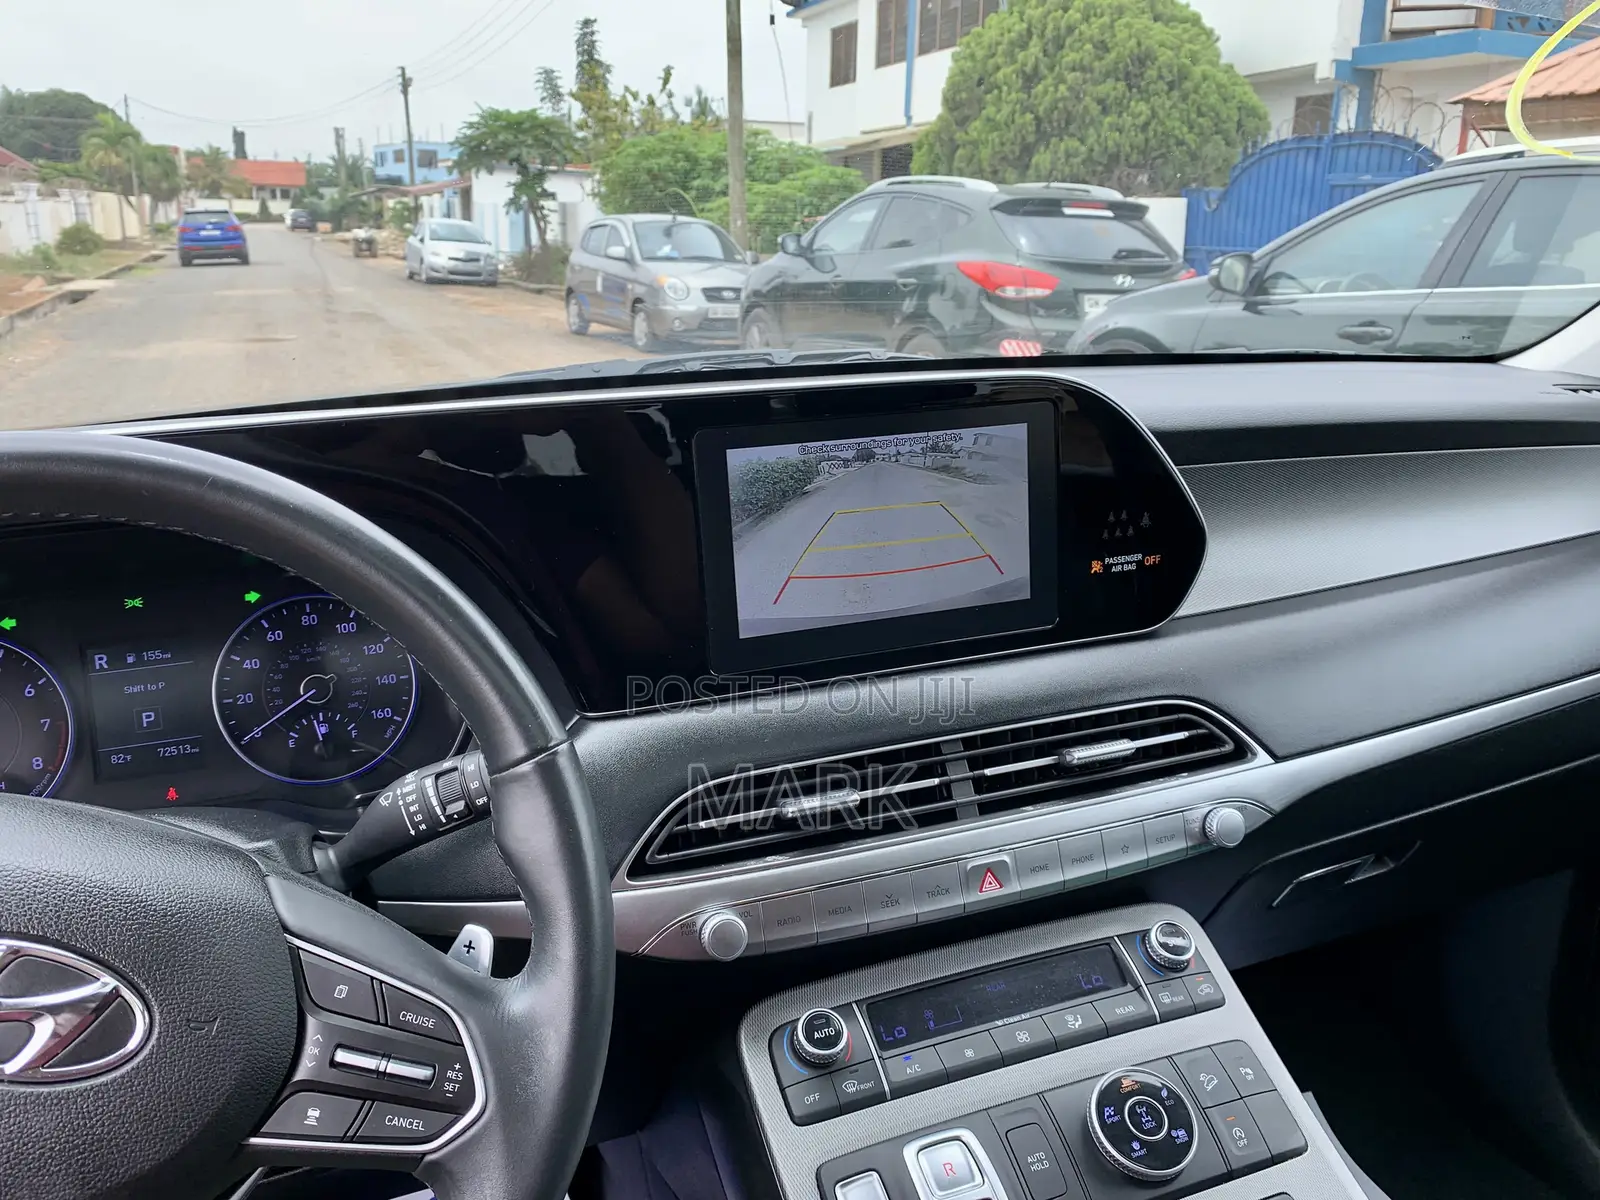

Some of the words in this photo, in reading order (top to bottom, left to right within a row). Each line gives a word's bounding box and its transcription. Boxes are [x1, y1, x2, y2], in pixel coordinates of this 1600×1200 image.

[798, 445, 828, 455] Check
[829, 440, 892, 452] surroundings
[894, 437, 908, 446] for
[909, 436, 931, 447] your
[932, 433, 963, 443] safety.
[1104, 554, 1142, 564] PASSENGER
[1144, 554, 1161, 565] OFF
[1123, 563, 1136, 571] BAG
[301, 614, 318, 626] 80
[336, 622, 356, 633] 100
[266, 630, 283, 642] 60
[362, 643, 384, 655] 120
[94, 654, 108, 669] R
[243, 658, 260, 669] 40
[376, 674, 397, 685] 140
[24, 684, 35, 697] 6
[124, 684, 144, 694] Shift
[147, 683, 156, 691] to
[236, 693, 254, 704] 20
[371, 708, 392, 719] 160
[40, 719, 50, 731] 7
[142, 712, 155, 727] P
[352, 730, 358, 738] F
[384, 724, 396, 739] MPH
[288, 739, 296, 748] E
[32, 757, 43, 770] 8
[402, 783, 416, 793] MIST
[470, 780, 479, 789] LO
[406, 794, 417, 803] OFF
[475, 796, 488, 806] OFF
[409, 804, 419, 812] INT
[1155, 834, 1176, 844] SETUP
[1071, 854, 1094, 864] PHONE
[1029, 863, 1050, 874] HOME
[926, 888, 950, 899] TRACK
[880, 898, 900, 909] SEEK
[828, 905, 852, 916] MEDIA
[680, 921, 696, 930] PWR
[777, 916, 801, 927] RADIO
[1114, 1005, 1135, 1015] REAR
[399, 1010, 435, 1028] CRUISE
[814, 1027, 835, 1040] AUTO
[308, 1046, 319, 1056] OK
[906, 1064, 922, 1075] A/C
[446, 1070, 463, 1081] RES
[444, 1082, 460, 1092] SET
[856, 1081, 875, 1092] FRONT
[1120, 1084, 1141, 1094] COMFORT
[804, 1093, 820, 1105] OFF
[385, 1115, 425, 1131] CANCEL
[1106, 1115, 1121, 1124] SPORT
[1142, 1121, 1157, 1130] LOCK
[1237, 1138, 1248, 1147] OFF
[1027, 1152, 1046, 1163] AUTO
[1130, 1148, 1148, 1158] SMART
[943, 1162, 956, 1177] R
[1030, 1160, 1049, 1172] HOLD
